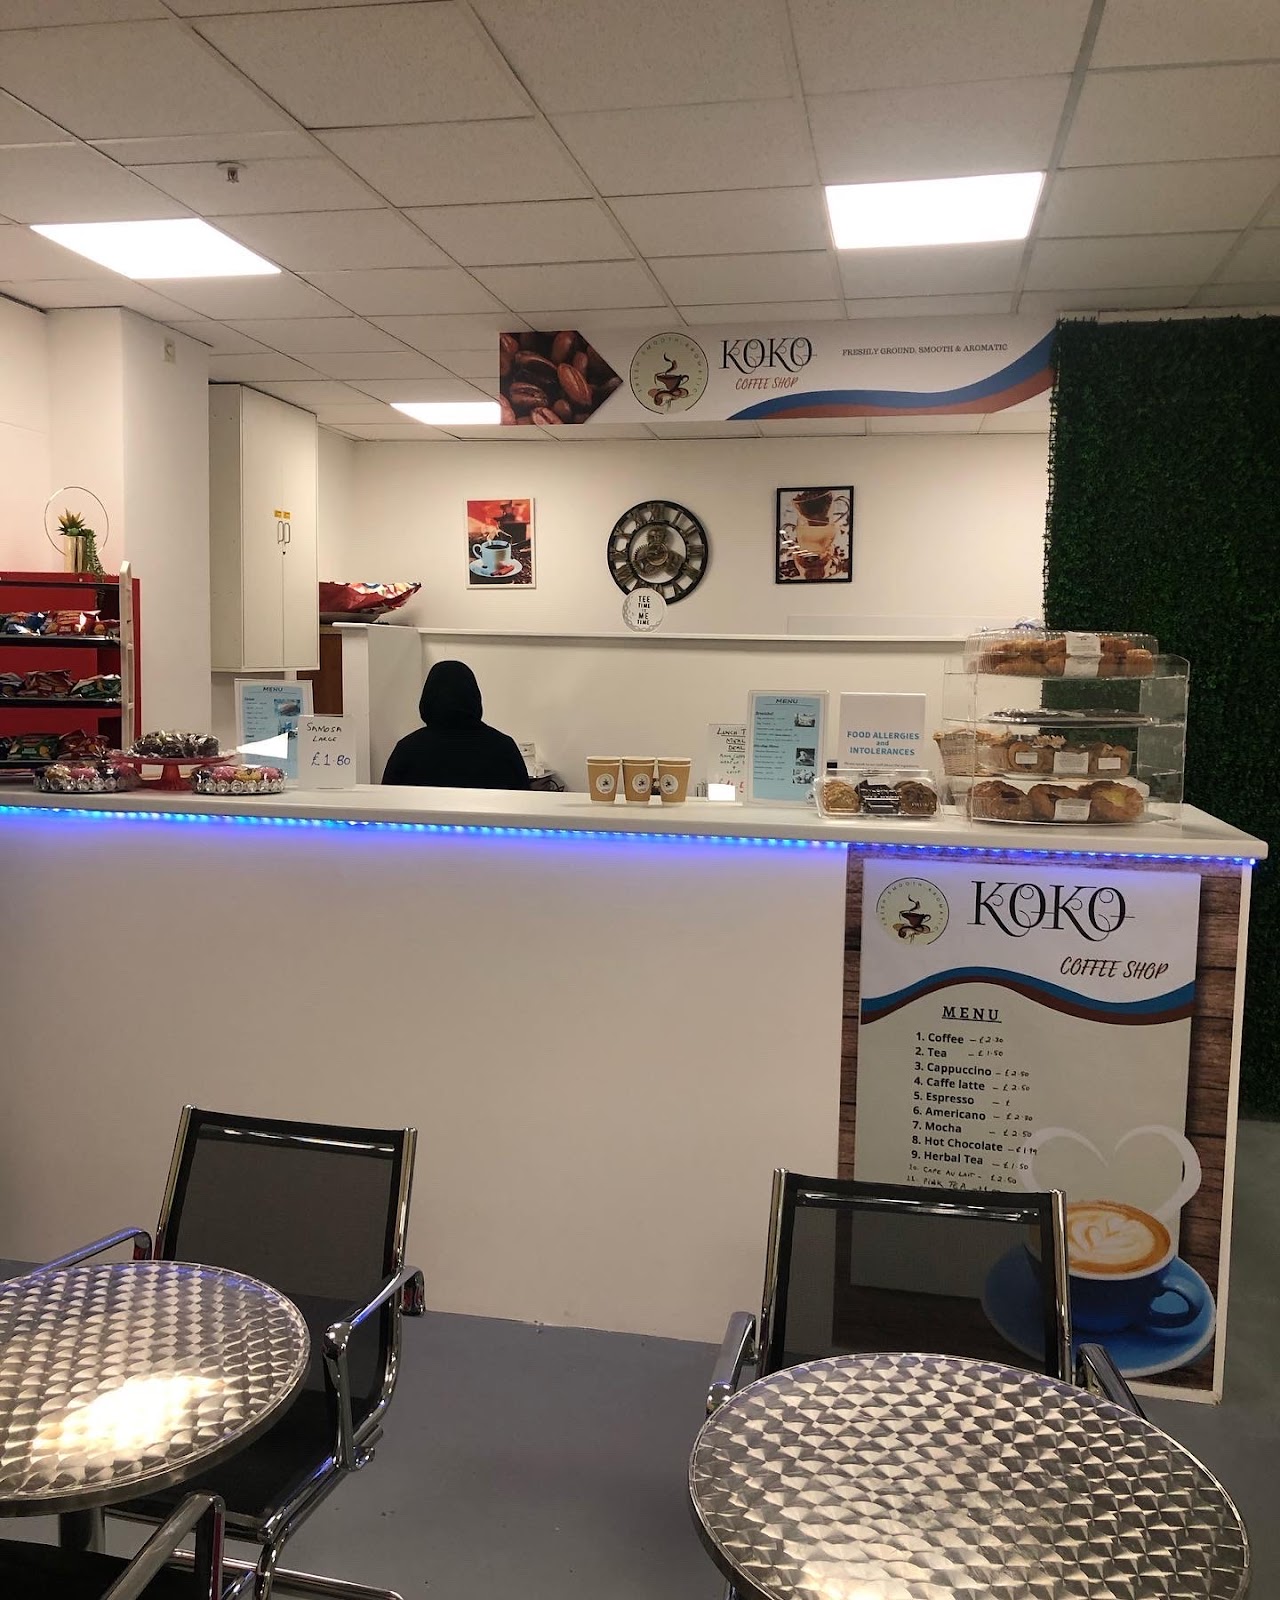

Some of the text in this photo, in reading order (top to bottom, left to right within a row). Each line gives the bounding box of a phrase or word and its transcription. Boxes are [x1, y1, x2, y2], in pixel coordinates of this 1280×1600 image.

[719, 337, 817, 374] KOKO
[842, 347, 879, 356] FRESHLY
[918, 345, 953, 354] SMOOTH
[963, 343, 1009, 352] AROMATIC
[735, 376, 799, 390] COFFEE SHOP
[638, 595, 650, 603] TEE
[638, 612, 649, 620] ME
[847, 731, 920, 740] FOOD ALLERGIES
[849, 747, 916, 756] INTOLERANCES
[967, 881, 1135, 942] KOKO
[1060, 956, 1169, 979] COFFEE SHOP
[942, 1006, 999, 1021] MENU
[916, 1032, 924, 1041] 1.
[928, 1033, 964, 1044] Coffee
[915, 1047, 924, 1056] 2.
[927, 1048, 947, 1058] Tea
[914, 1062, 923, 1071] 3.
[927, 1063, 992, 1076] Cappuccino
[914, 1077, 923, 1086] 4.
[926, 1078, 955, 1089] Caffe
[959, 1080, 985, 1090] latte
[913, 1092, 922, 1101] 5.
[926, 1092, 974, 1105] Espresso
[913, 1106, 922, 1115] 6.
[925, 1107, 986, 1120] Americano
[913, 1121, 922, 1130] 7.
[925, 1122, 962, 1133] Mocha
[912, 1136, 921, 1144] 8.
[924, 1137, 944, 1147] Hot
[947, 1139, 1003, 1152] Chocolate
[911, 1150, 920, 1159] 9.
[924, 1151, 961, 1163] Herbal
[964, 1154, 983, 1165] Tea
